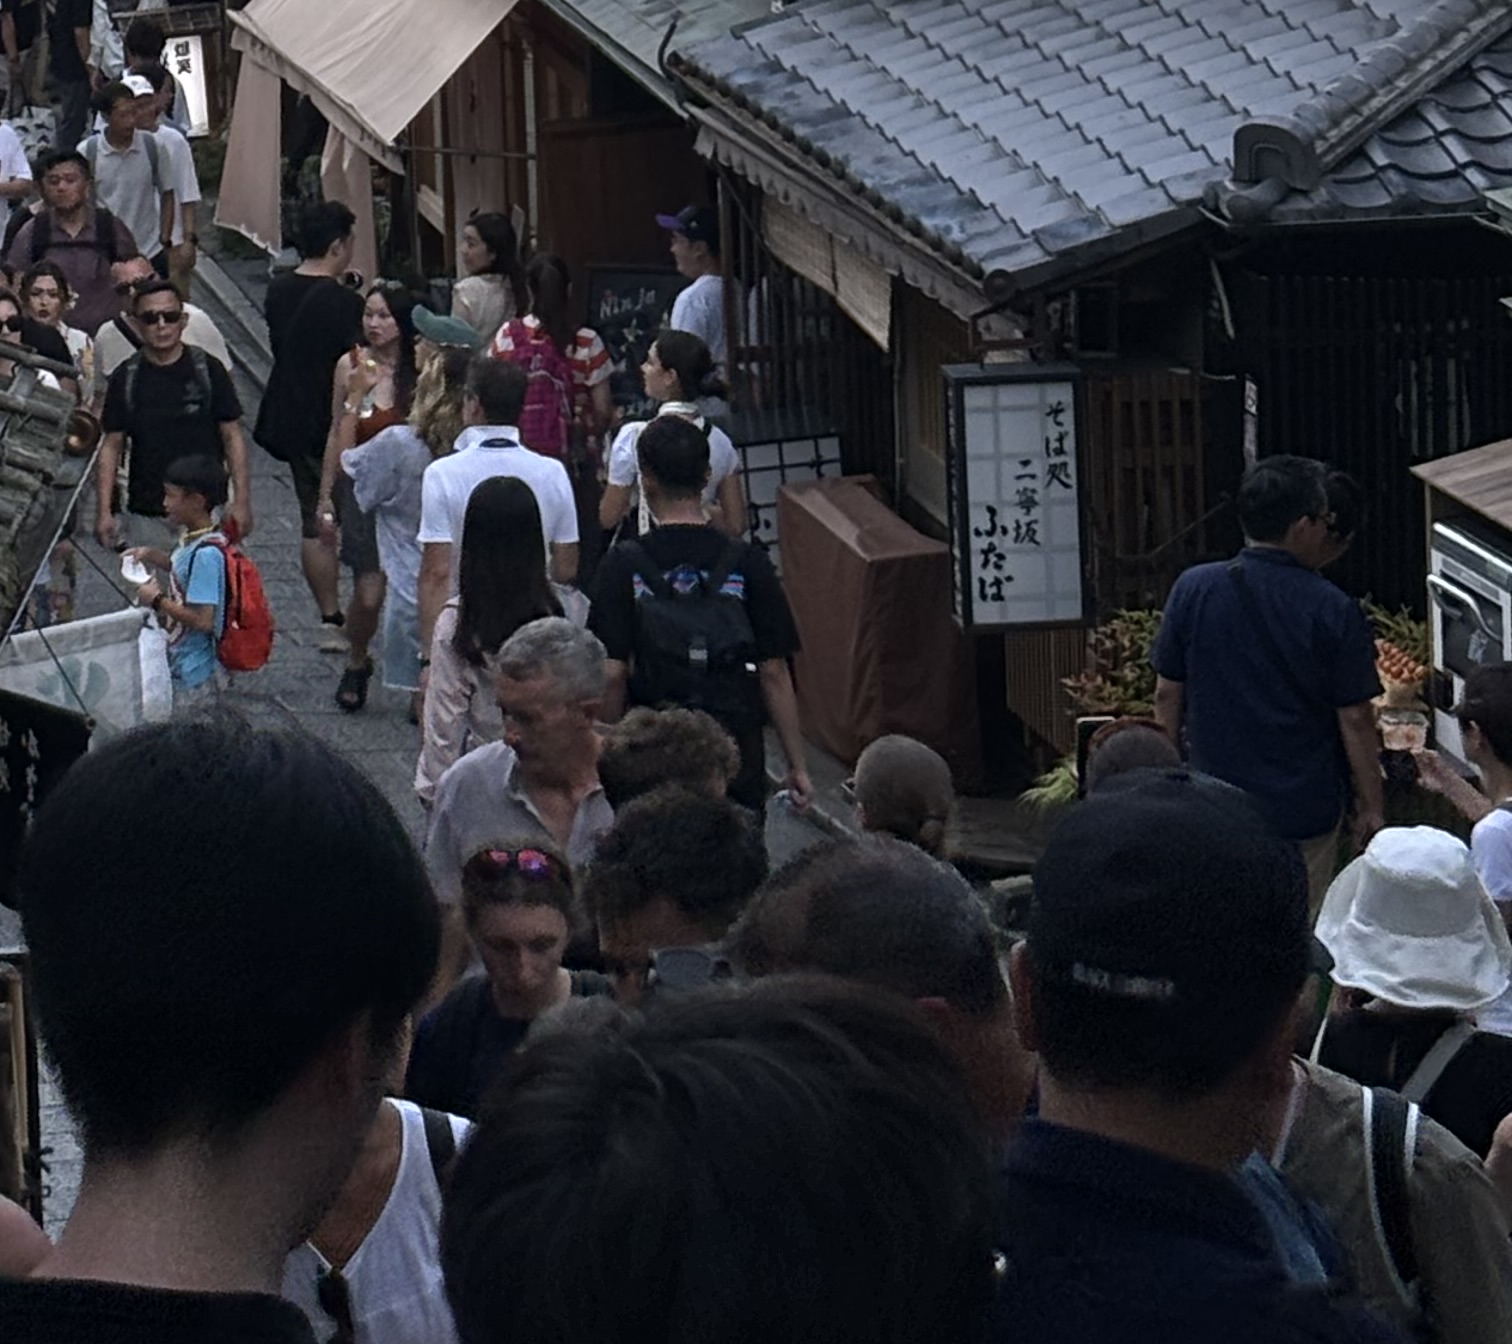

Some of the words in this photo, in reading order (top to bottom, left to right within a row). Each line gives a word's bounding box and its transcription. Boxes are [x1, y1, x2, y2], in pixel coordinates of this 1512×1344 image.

[1045, 400, 1073, 490] そば処
[1012, 459, 1041, 547] 二寧坂
[973, 505, 1015, 603] ふたば
